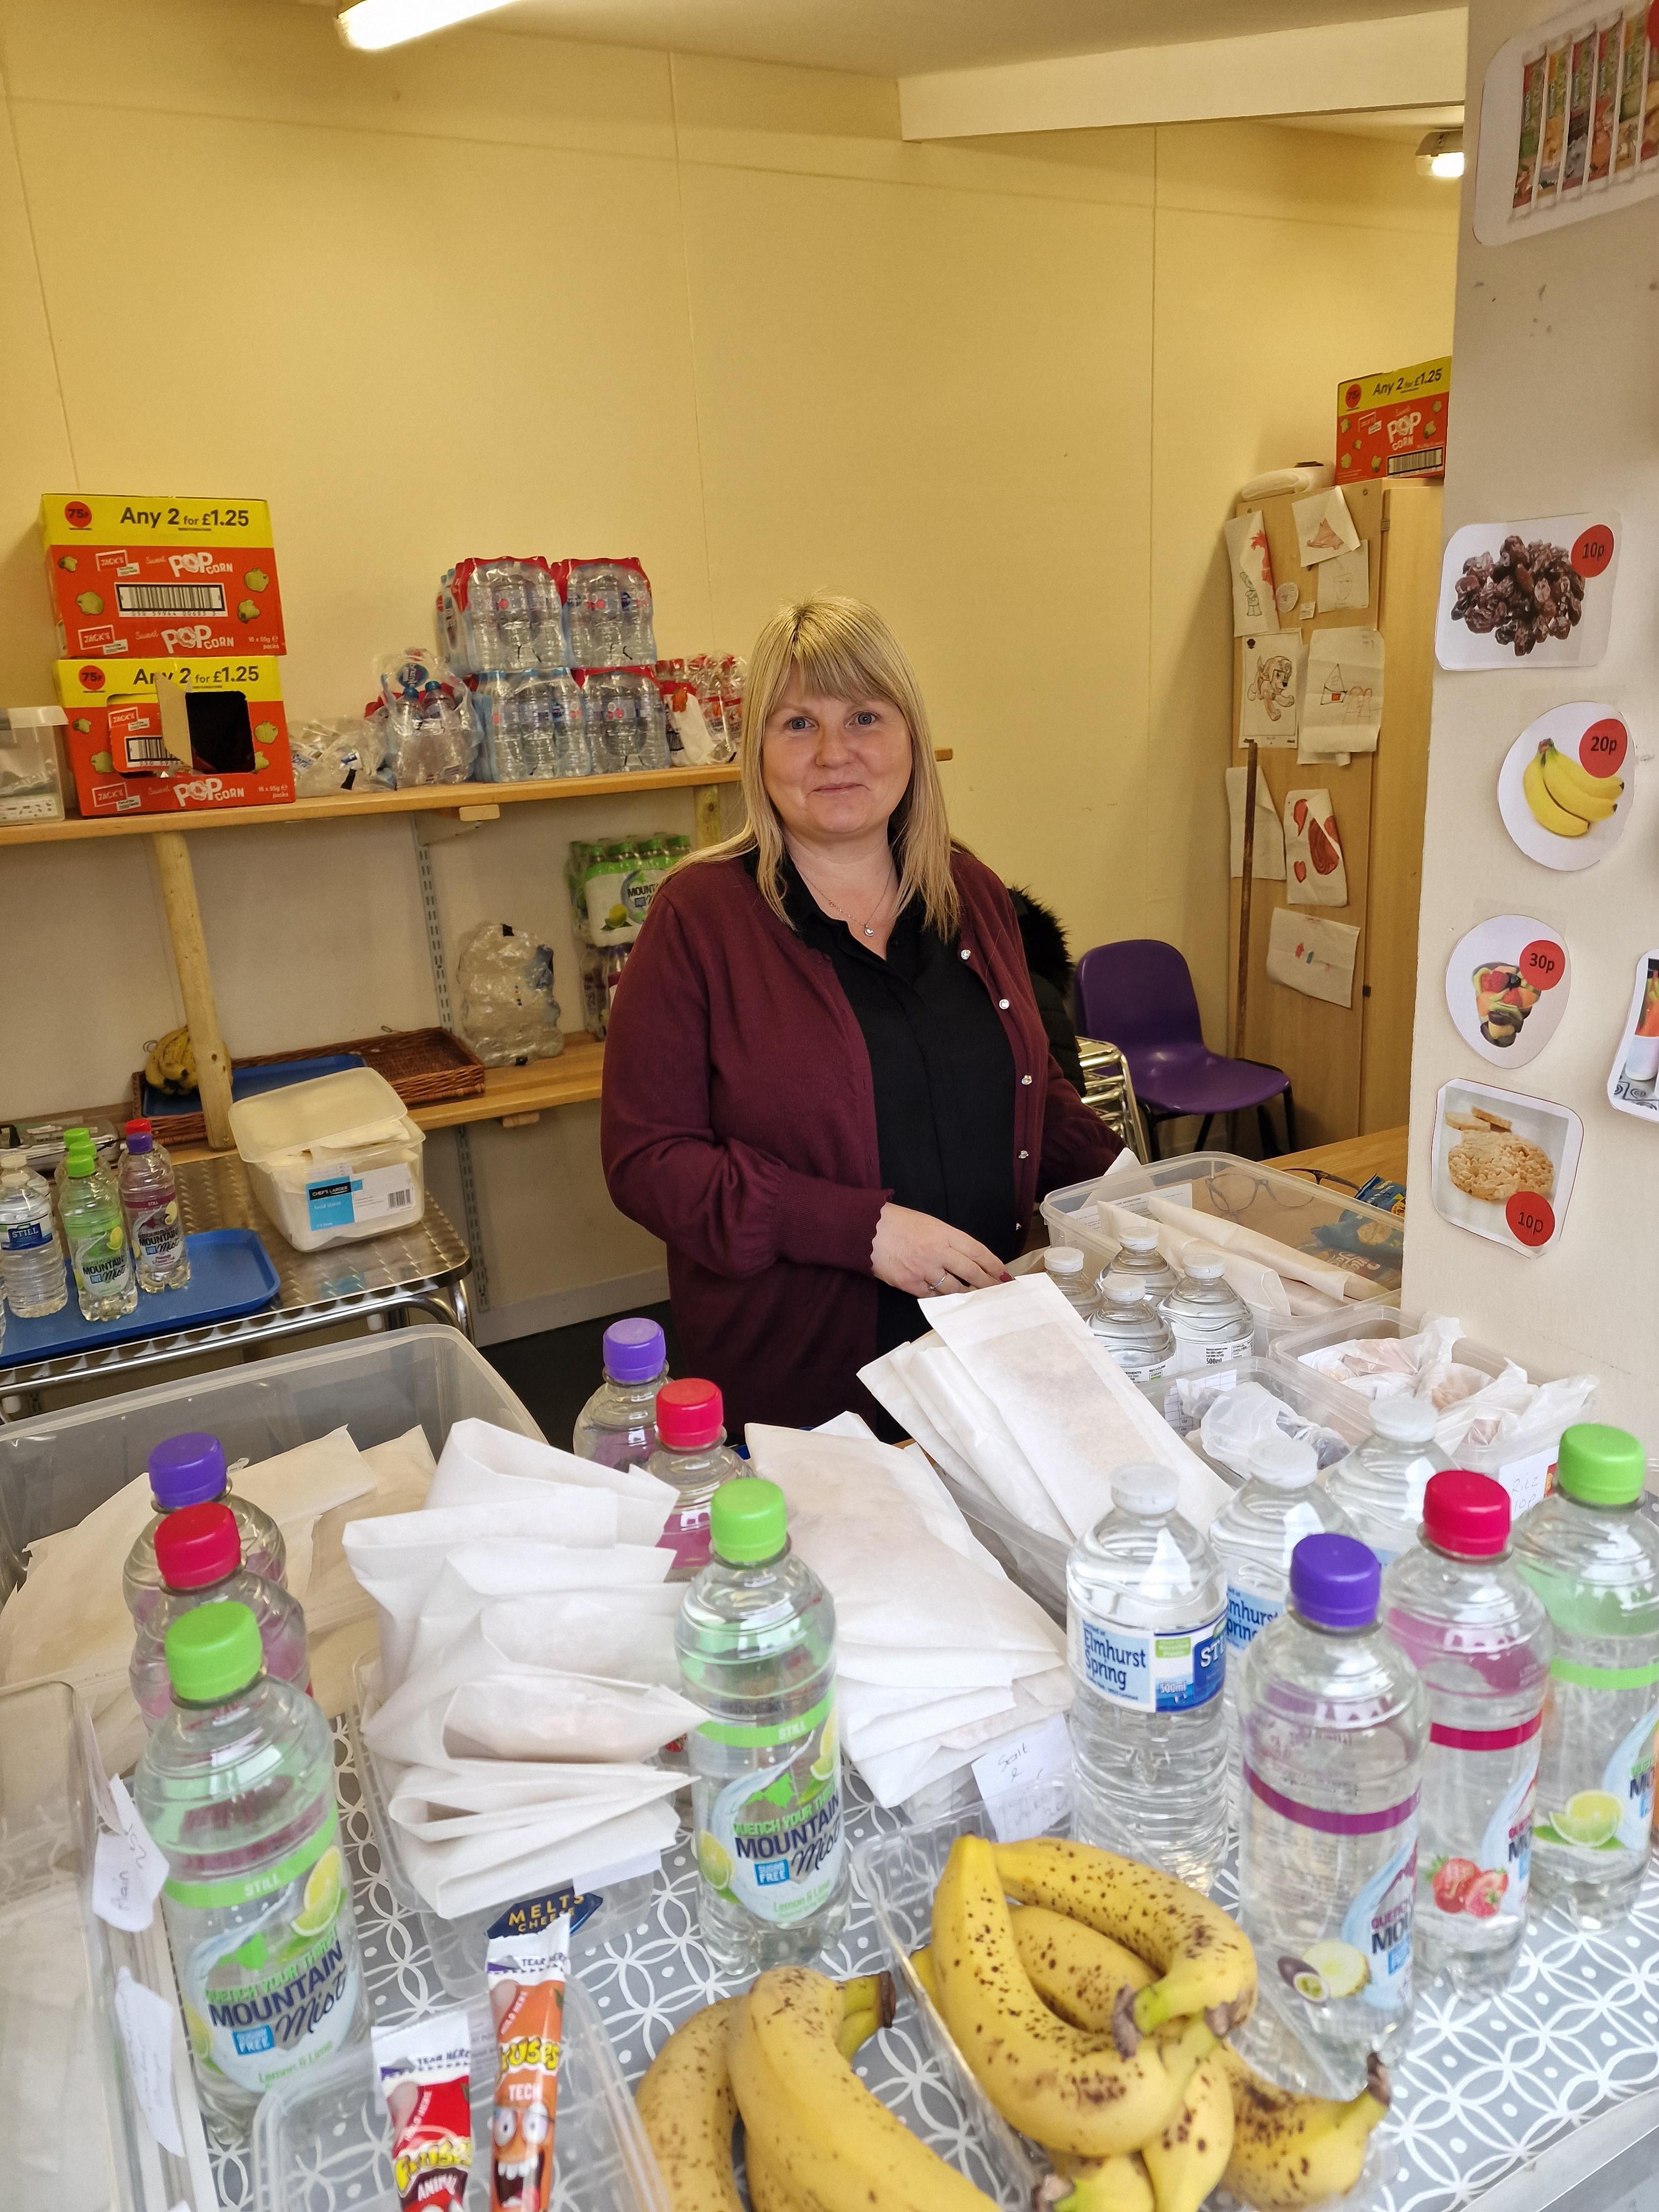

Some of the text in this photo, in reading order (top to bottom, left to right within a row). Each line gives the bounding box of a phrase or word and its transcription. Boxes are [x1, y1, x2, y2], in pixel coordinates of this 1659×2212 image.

[1373, 382, 1394, 396] Any
[1396, 378, 1404, 390] 2
[1414, 368, 1443, 387] £1.25
[1386, 411, 1422, 444] POP
[120, 507, 249, 529] Any 2 for £1.25
[1583, 541, 1605, 561] 10p
[168, 552, 213, 578] POP
[206, 562, 233, 575] CORN
[160, 625, 212, 654] POP
[203, 637, 234, 650] CORN
[179, 667, 191, 685] 2
[195, 674, 210, 684] for
[213, 665, 259, 683] £1.25
[1590, 736, 1618, 755] 20p
[173, 778, 223, 807] POP
[216, 787, 244, 800] CORN
[627, 883, 659, 898] MOUNT
[1529, 953, 1555, 974] 30p
[12, 1227, 39, 1239] STILL
[1518, 1212, 1543, 1235] 10p
[138, 1229, 178, 1247] MOUNTAIN
[157, 1238, 180, 1253] Mist
[82, 1255, 124, 1275] MOUNTAIN
[102, 1264, 126, 1281] Mist
[1227, 1599, 1278, 1626] mhurs
[1227, 1618, 1257, 1642] prin
[1083, 1627, 1146, 1668] Elmhurst
[1084, 1648, 1127, 1691] Spring
[1159, 1681, 1187, 1694] 500ml
[778, 1720, 806, 1741] STILL
[734, 1790, 840, 1859] MOUNTAIN
[782, 1807, 813, 1832] YOUR
[244, 1874, 279, 1898] STILL
[758, 1870, 790, 1885] FREE
[508, 1894, 585, 1927] MELTS
[518, 1907, 575, 1933] CHEEE
[521, 1958, 546, 1966] TEAR
[207, 1940, 343, 2028] MOUNTAIN
[275, 1963, 347, 2043] Mist
[418, 2054, 443, 2065] TEAR
[508, 2083, 541, 2102] TECH
